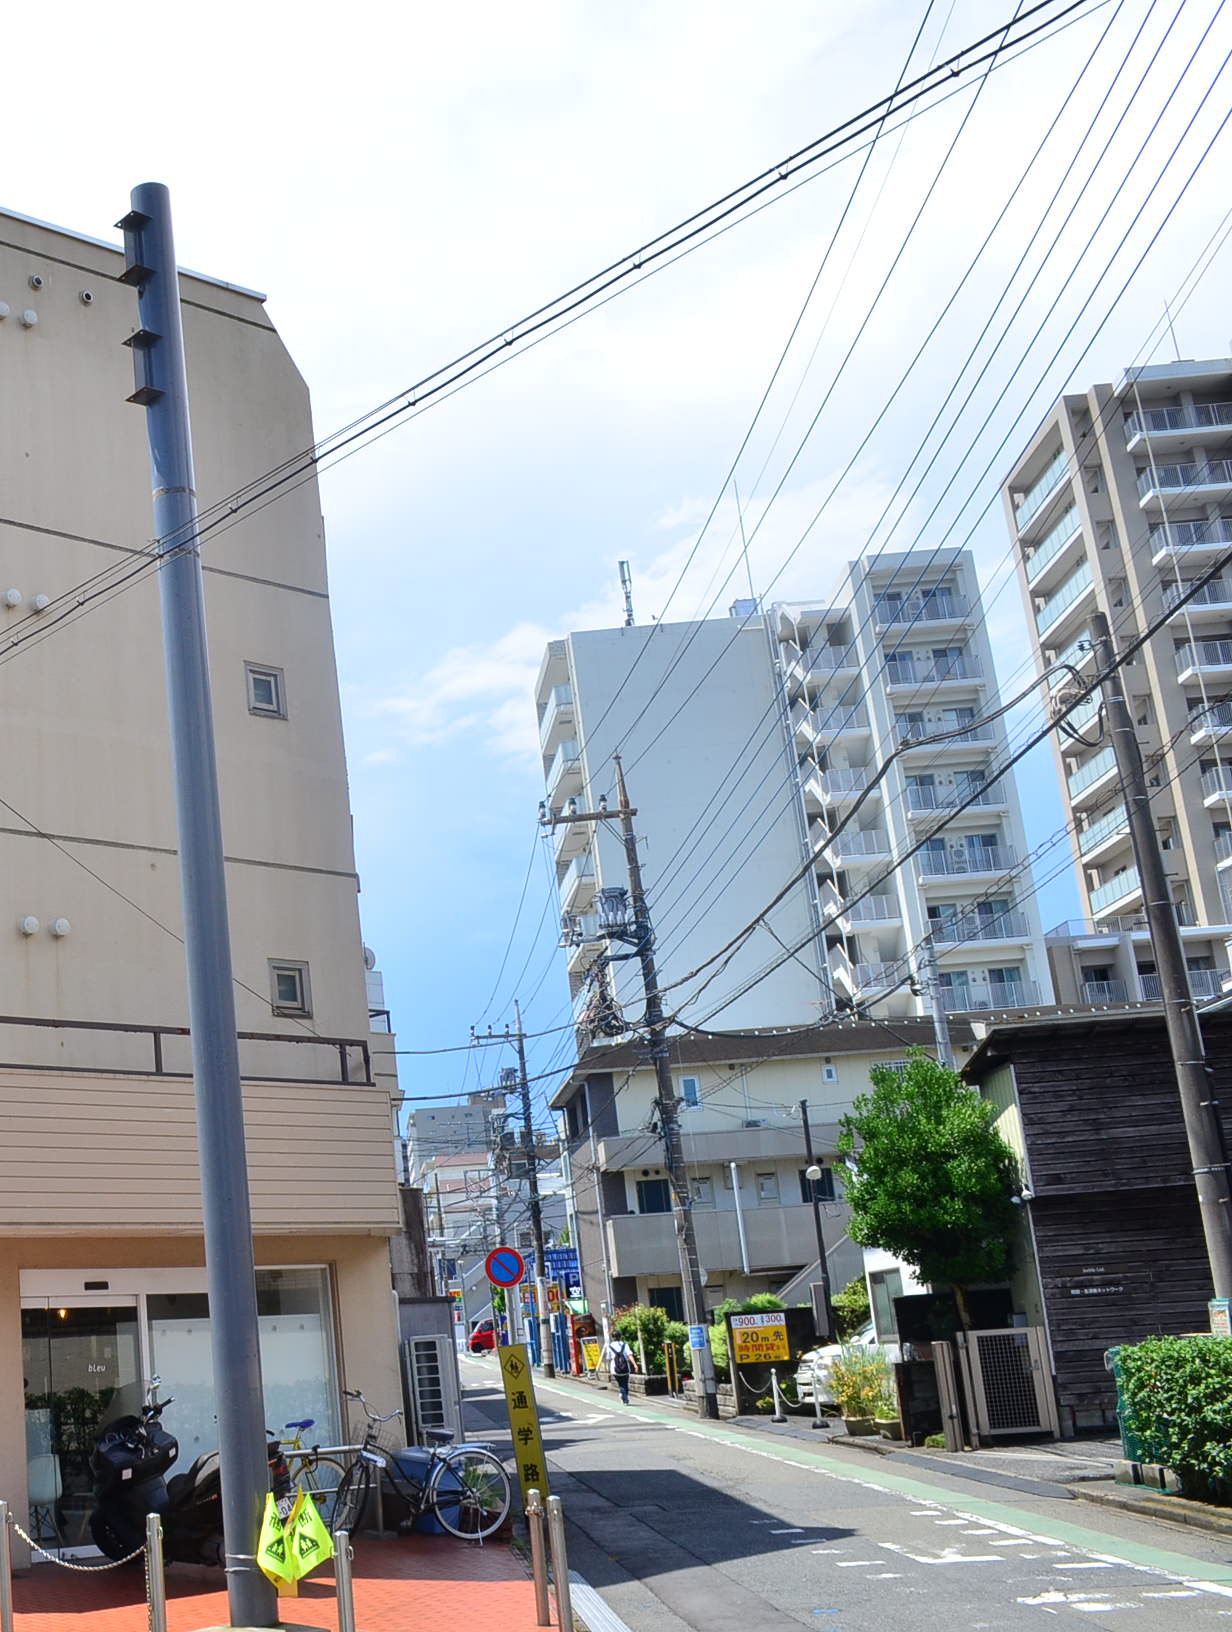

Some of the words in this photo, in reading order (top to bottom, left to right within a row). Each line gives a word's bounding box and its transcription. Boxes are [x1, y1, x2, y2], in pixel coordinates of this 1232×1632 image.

[88, 1362, 106, 1373] bleu
[511, 1391, 541, 1483] 通学路
